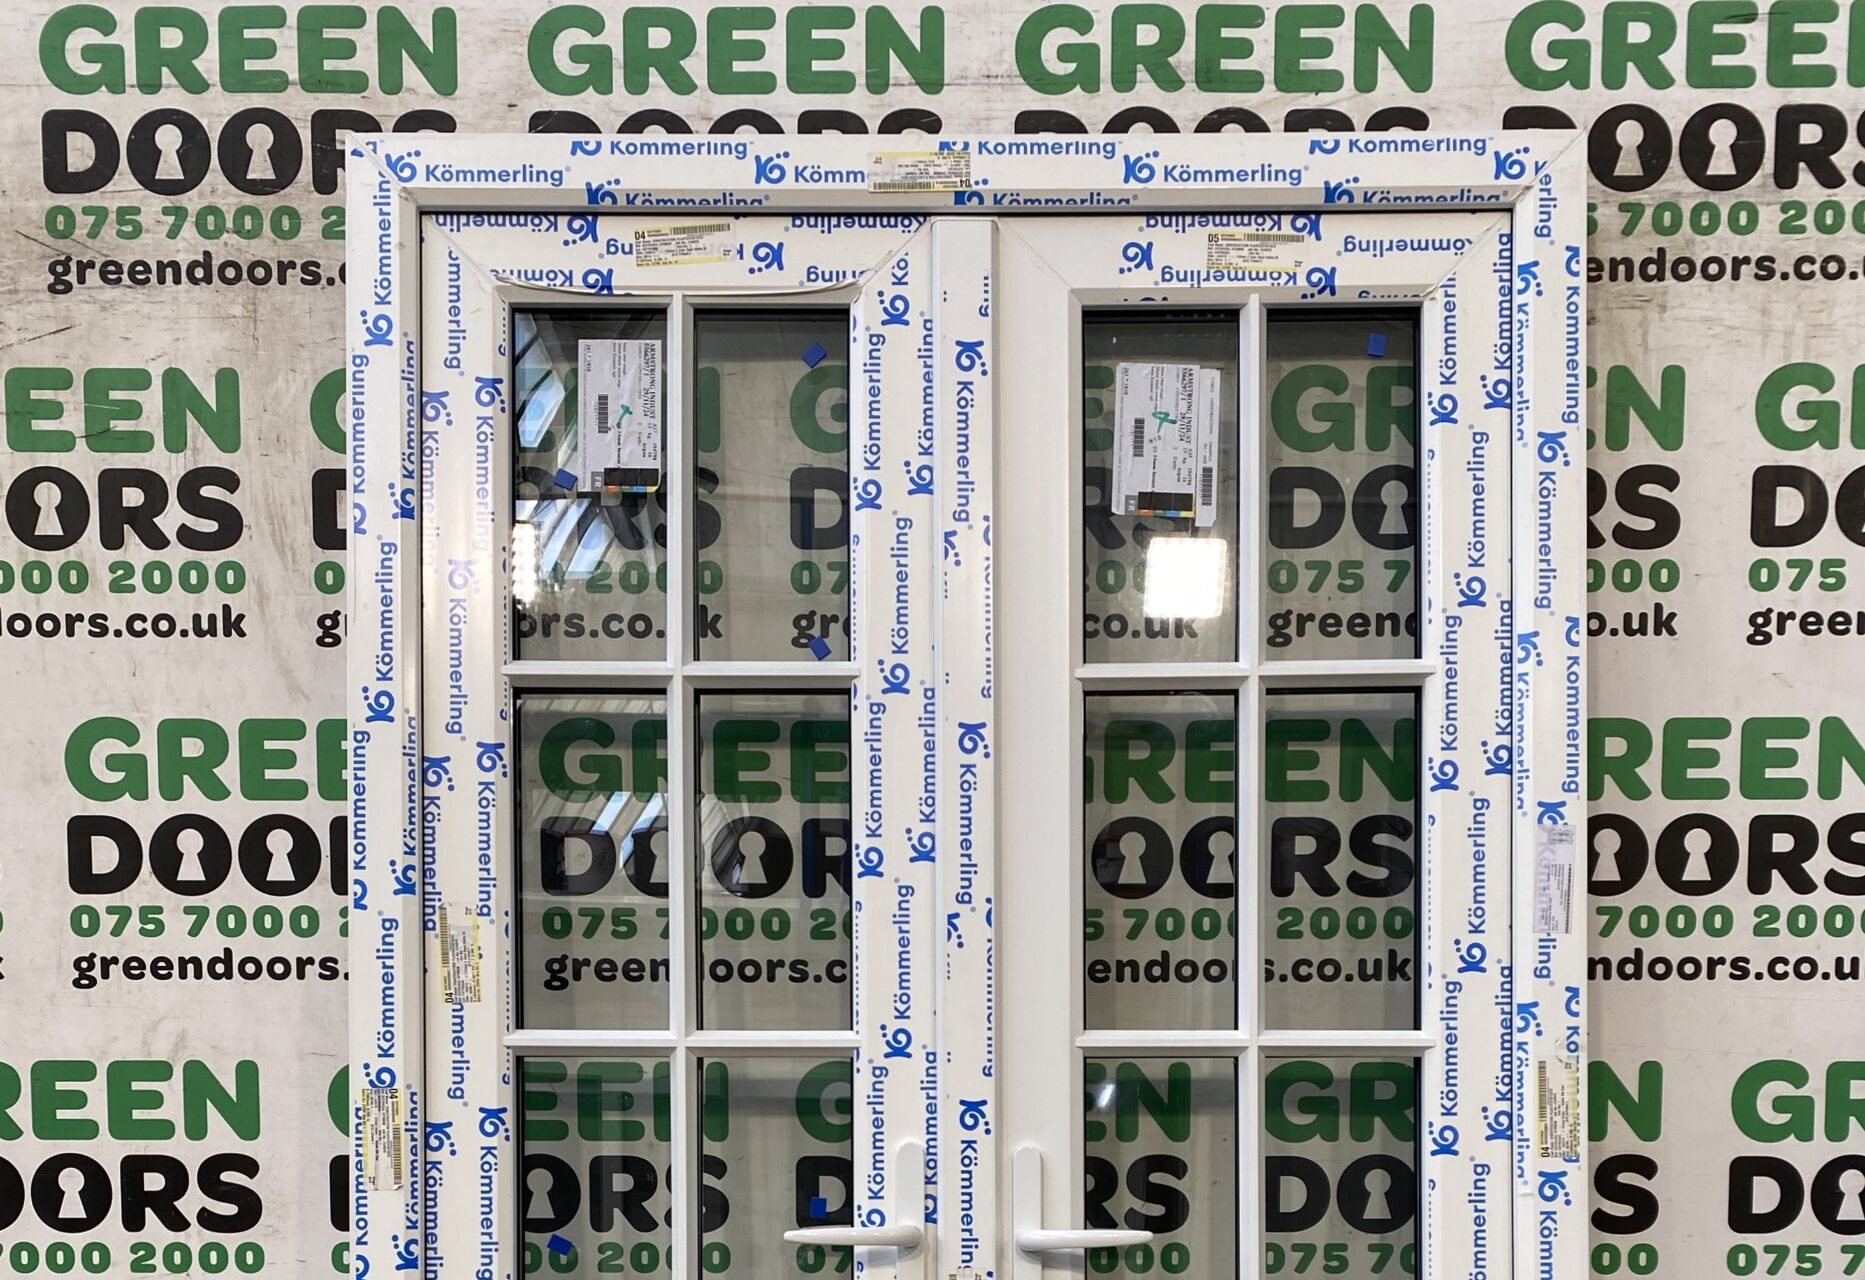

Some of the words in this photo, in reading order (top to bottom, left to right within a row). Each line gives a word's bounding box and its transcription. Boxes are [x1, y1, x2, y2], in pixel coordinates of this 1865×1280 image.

[39, 5, 457, 96] GREEN
[528, 5, 944, 96] GREEN
[1015, 4, 1434, 95] GREEN
[1505, 0, 1865, 91] GREE
[45, 206, 142, 239] 075
[162, 205, 300, 240] 7000
[1620, 201, 1759, 236] 7000
[635, 231, 645, 240] 04
[1208, 234, 1219, 242] 05
[594, 476, 602, 487] FR
[1128, 500, 1135, 511] FR
[109, 561, 246, 594] 2000
[1267, 560, 1365, 594] 075
[1749, 558, 1846, 592] 075
[70, 905, 165, 937] 075
[183, 905, 320, 938] 7000
[542, 906, 638, 940] 075
[1276, 907, 1414, 940] 2000
[1596, 905, 1733, 938] 7000
[445, 992, 454, 1003] 04
[389, 1088, 398, 1099] 04
[1541, 1147, 1550, 1157] 04
[130, 1242, 264, 1274] 2000
[1727, 1244, 1822, 1276] 075
